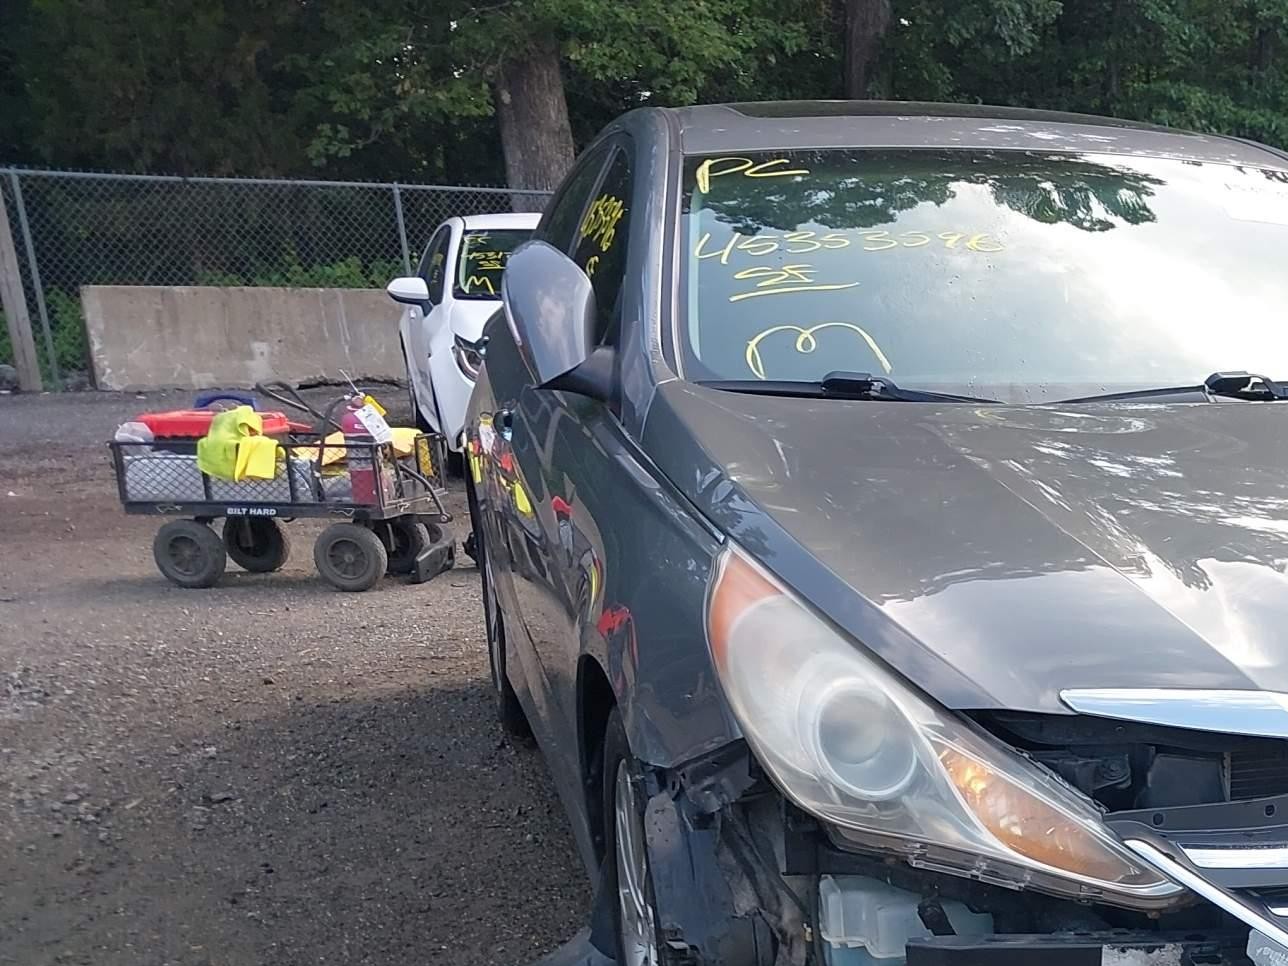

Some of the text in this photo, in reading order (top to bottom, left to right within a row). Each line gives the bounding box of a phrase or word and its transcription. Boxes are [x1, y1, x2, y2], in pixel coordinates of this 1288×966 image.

[694, 231, 1006, 264] 45353596
[226, 507, 277, 516] BILT HARD
